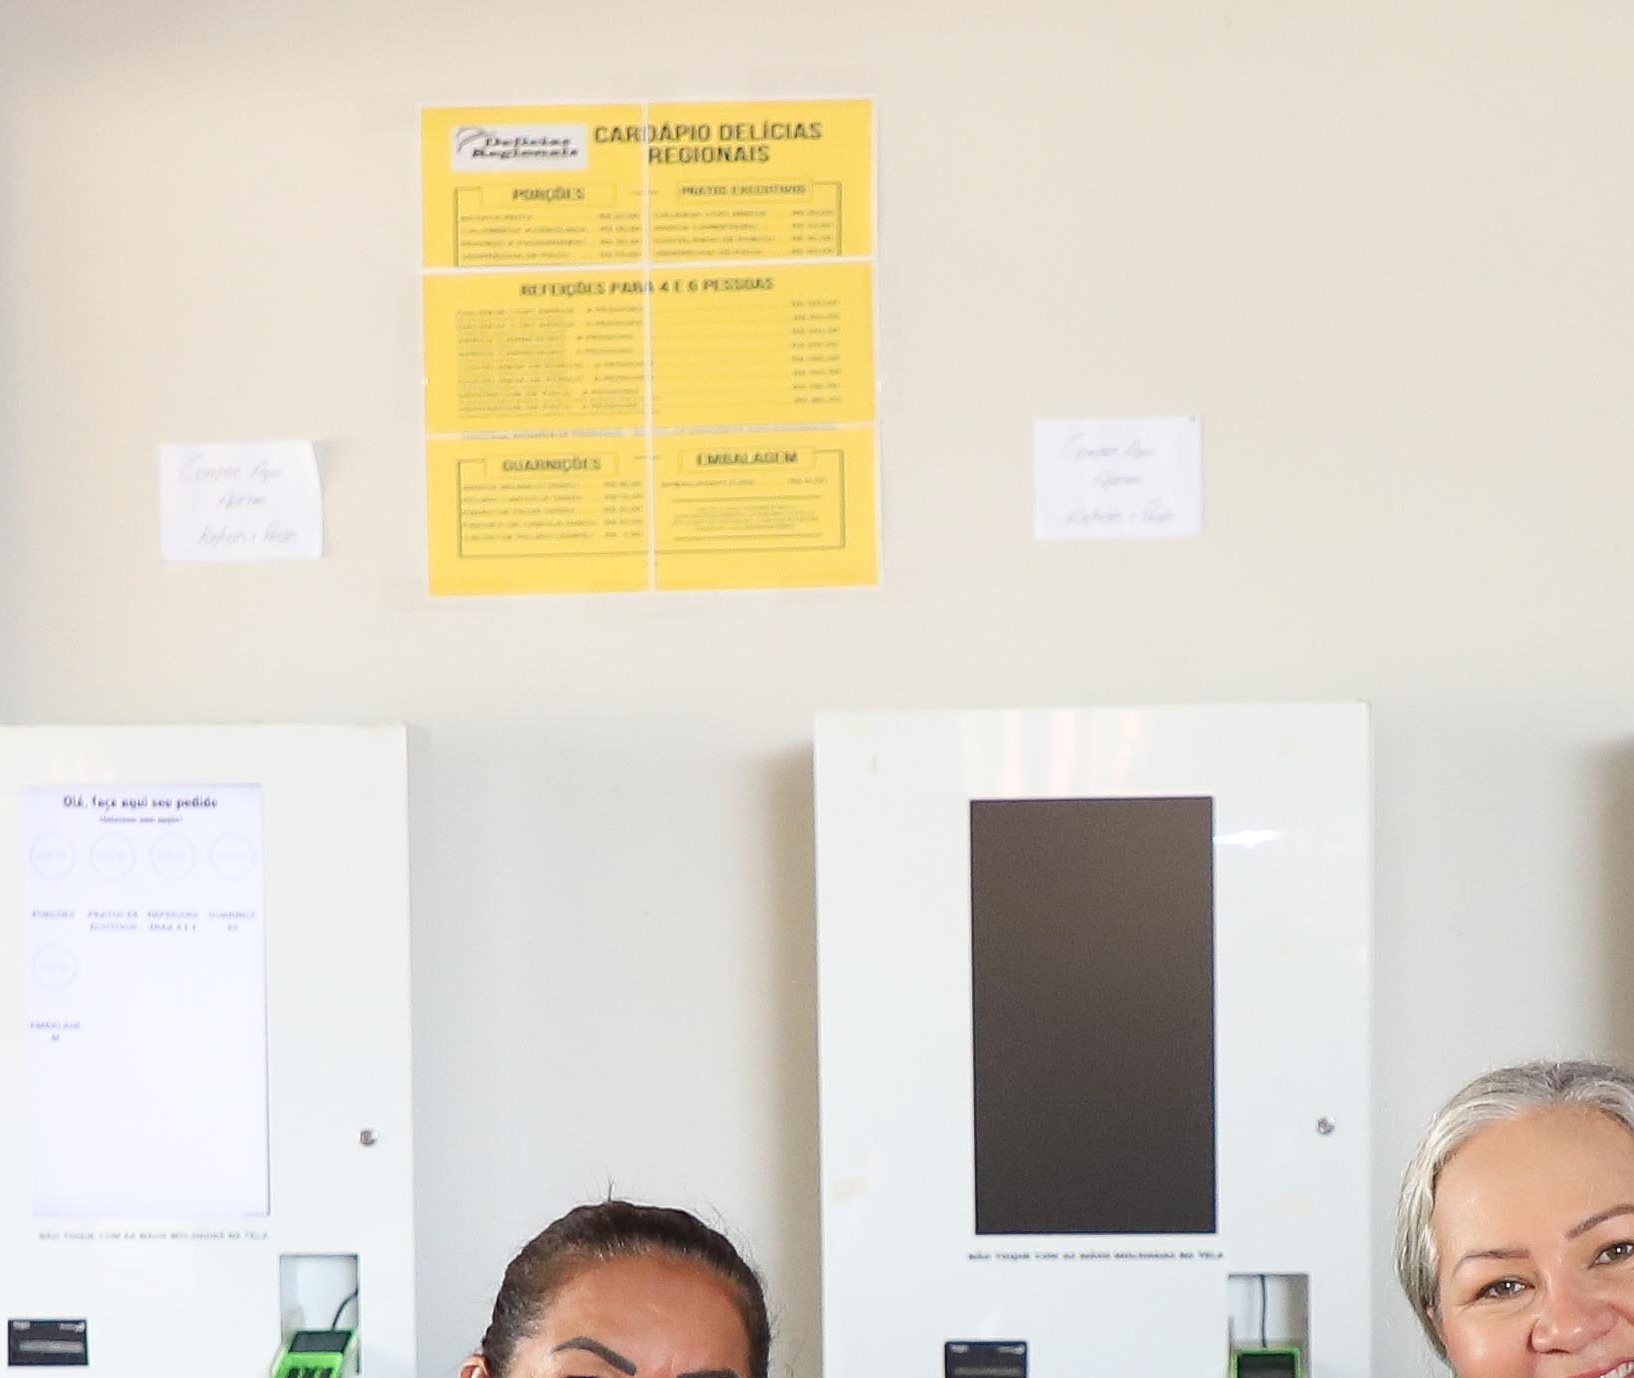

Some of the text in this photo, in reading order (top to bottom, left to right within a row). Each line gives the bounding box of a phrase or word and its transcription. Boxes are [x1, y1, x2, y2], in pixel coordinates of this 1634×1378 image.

[594, 119, 824, 144] CARDÁPIO DELÍCIAS
[647, 145, 770, 164] REGIONAIS
[521, 281, 606, 297] REFEIÇÕES
[610, 281, 654, 295] PARA
[660, 280, 670, 293] 4
[703, 277, 775, 291] PESSOAS
[502, 456, 602, 473] GUARNIÇÕES
[696, 450, 798, 466] EMBALAGEM
[176, 794, 219, 811] pedido
